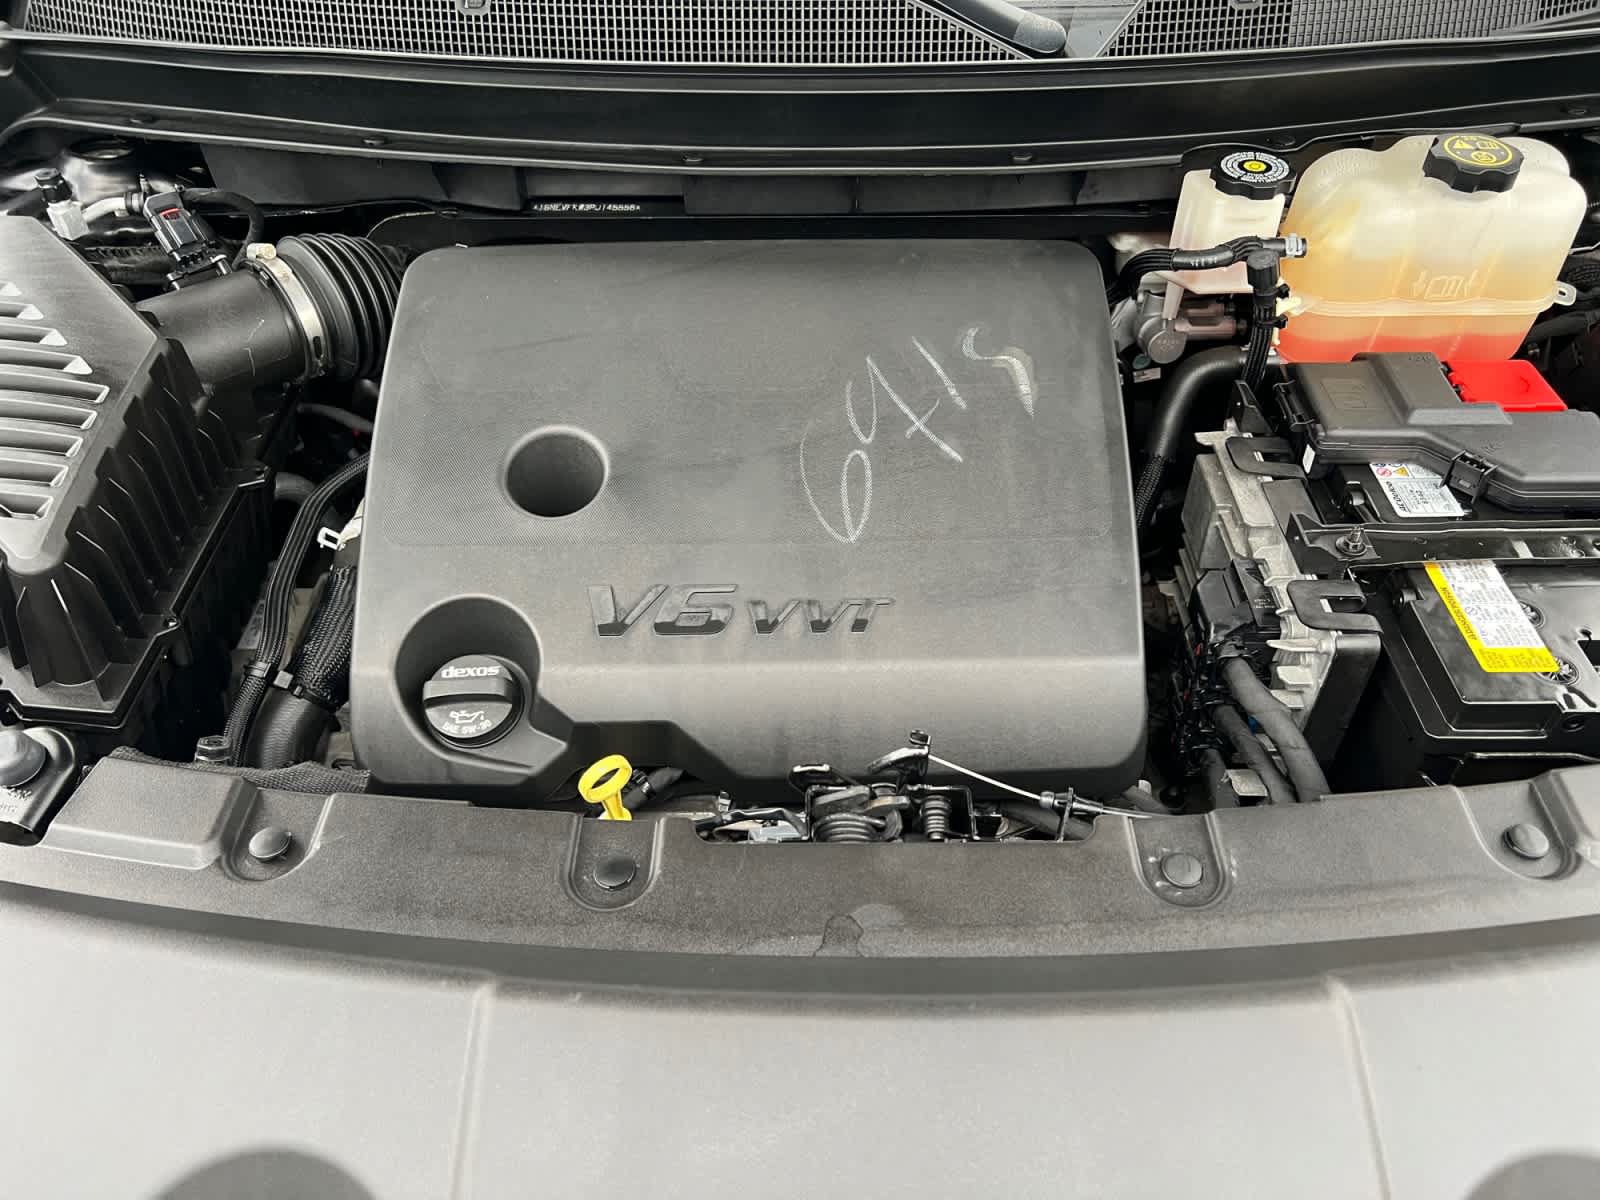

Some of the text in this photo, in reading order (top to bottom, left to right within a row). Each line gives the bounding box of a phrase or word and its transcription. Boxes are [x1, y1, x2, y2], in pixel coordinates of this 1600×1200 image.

[587, 584, 895, 636] V6 VVT
[441, 666, 502, 678] dexos
